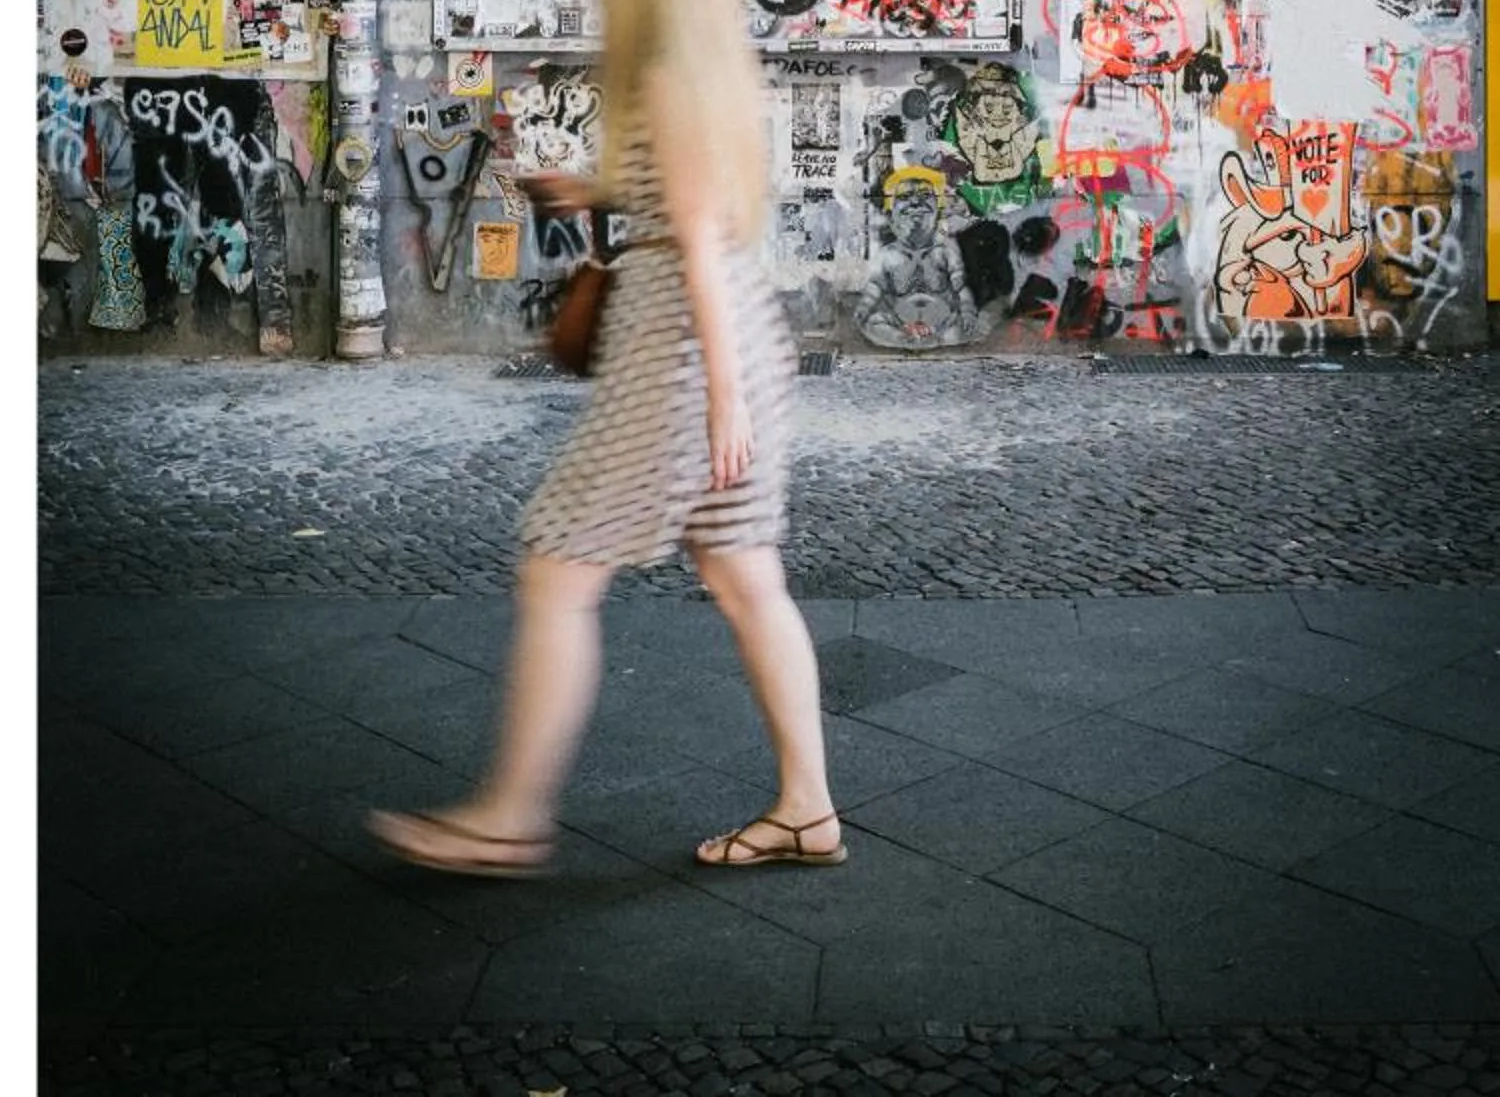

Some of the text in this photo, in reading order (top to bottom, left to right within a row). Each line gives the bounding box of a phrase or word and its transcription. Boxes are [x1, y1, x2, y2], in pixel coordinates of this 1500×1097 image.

[1290, 132, 1340, 166] VOTE
[791, 164, 838, 179] TRACE
[1301, 165, 1330, 187] FOR
